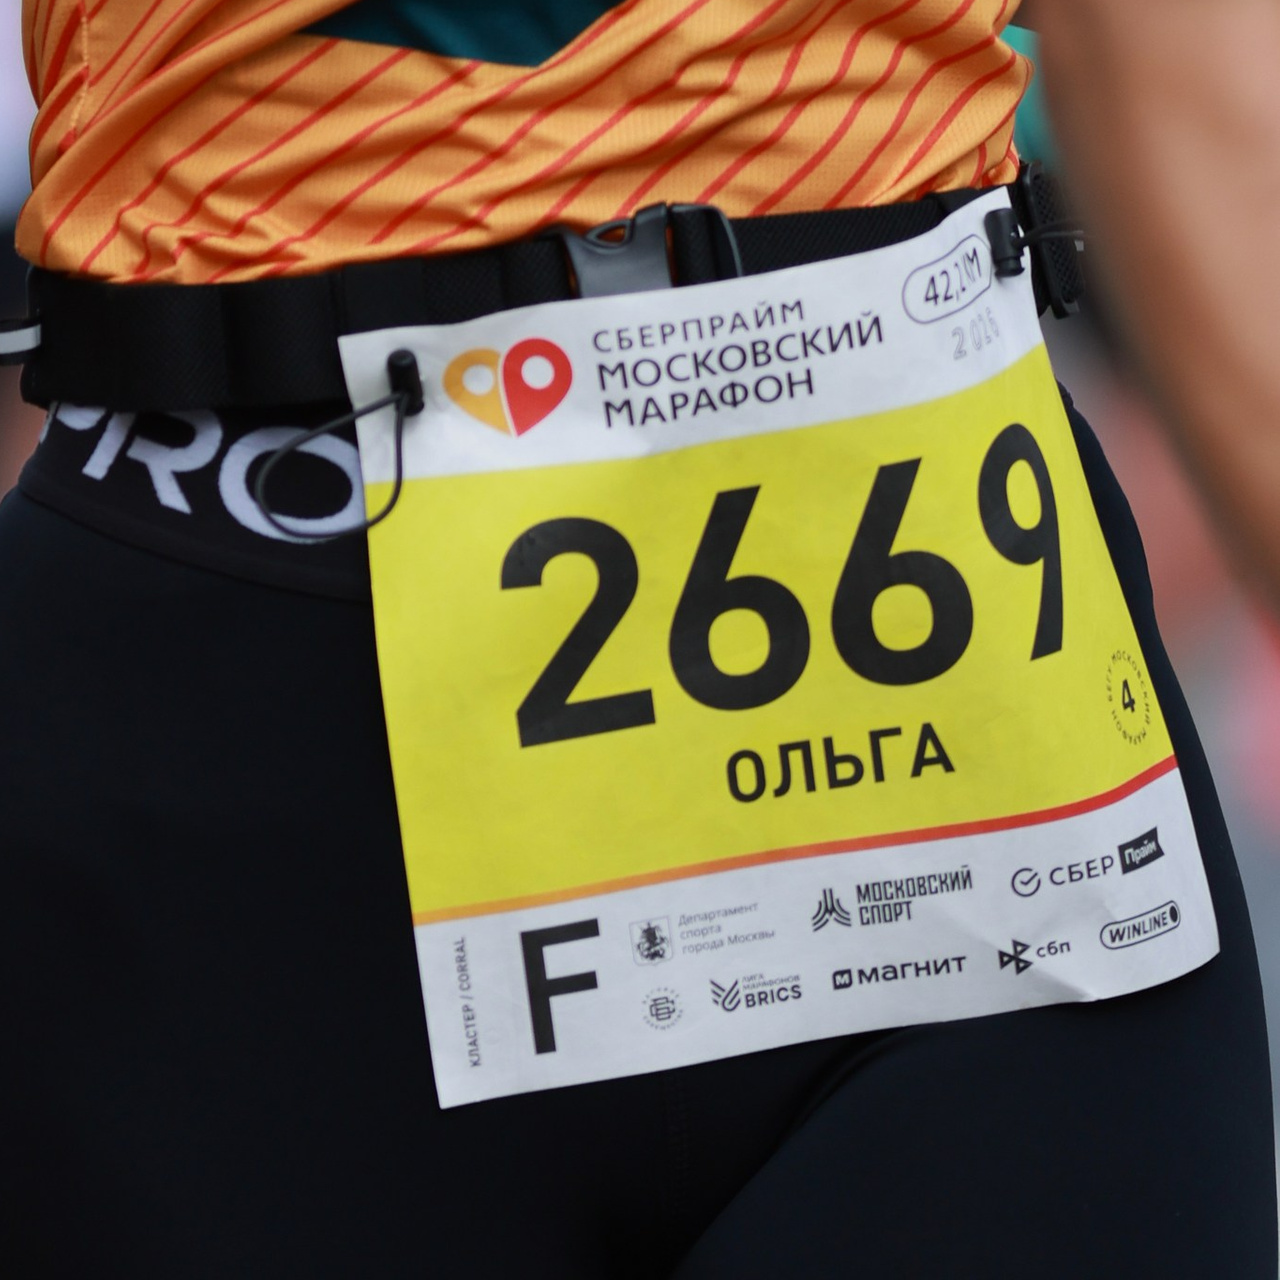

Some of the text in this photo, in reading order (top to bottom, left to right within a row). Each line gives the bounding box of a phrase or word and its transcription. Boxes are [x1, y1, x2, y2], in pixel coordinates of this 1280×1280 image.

[593, 300, 803, 353] СБЕРПРАЙМ
[597, 311, 883, 391] МОСКОВСКИЙ
[604, 368, 814, 428] МАРАФОН
[500, 423, 1063, 748] 2669
[1122, 679, 1135, 713] 4
[727, 722, 955, 803] ОЛЬГА
[856, 864, 973, 904] МОСКОВСКИЙ
[1049, 839, 1157, 886] СБЕР Прайм
[678, 902, 759, 927] Департамент
[680, 924, 722, 940] спорта
[859, 900, 912, 926] СПОРТ
[1109, 911, 1168, 943] WINLINE
[682, 929, 775, 954] города Москвы
[1036, 941, 1072, 958] сбп
[454, 935, 471, 992] CORRAL
[520, 917, 600, 1055] F
[745, 984, 803, 1008] BRICS
[462, 1004, 481, 1067] КЛАСТЕР
